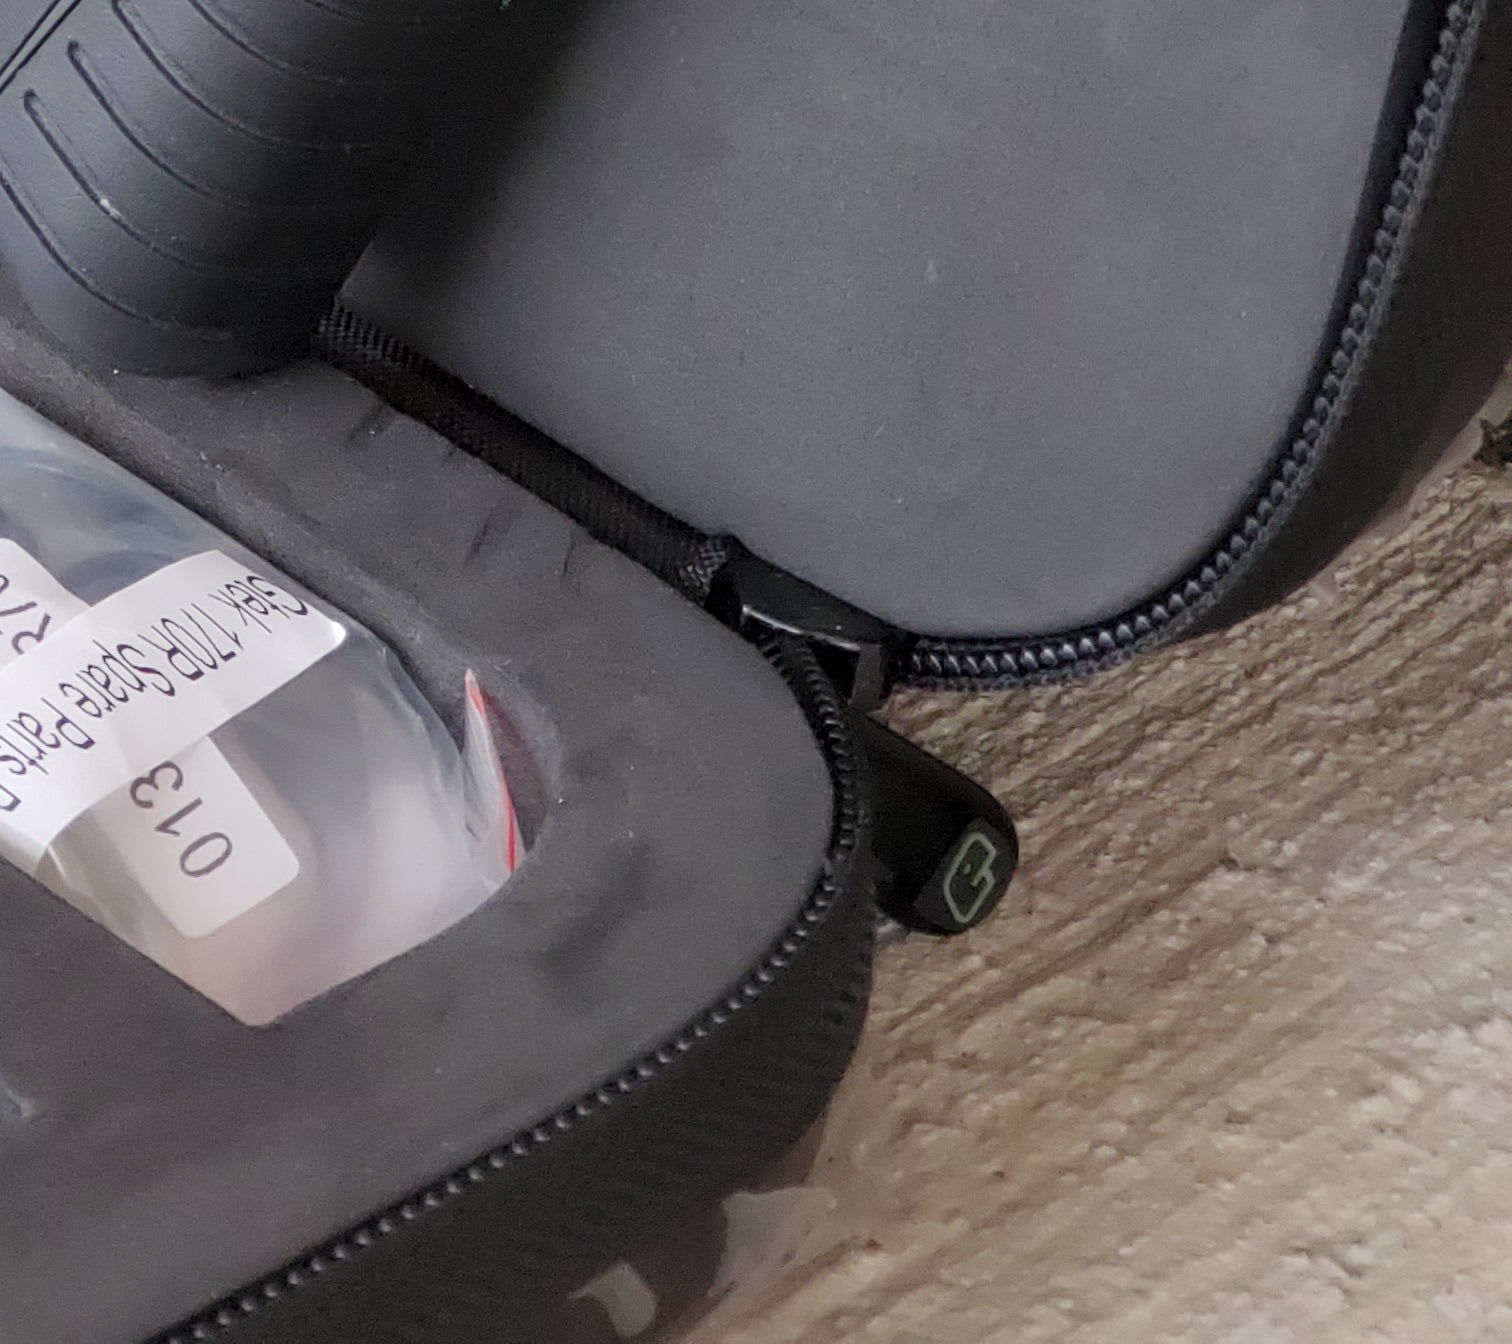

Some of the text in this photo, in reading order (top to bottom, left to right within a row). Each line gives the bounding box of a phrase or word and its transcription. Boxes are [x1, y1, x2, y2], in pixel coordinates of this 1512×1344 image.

[140, 602, 242, 682] 170R
[211, 574, 308, 633] Gtek
[60, 640, 176, 720] Spare
